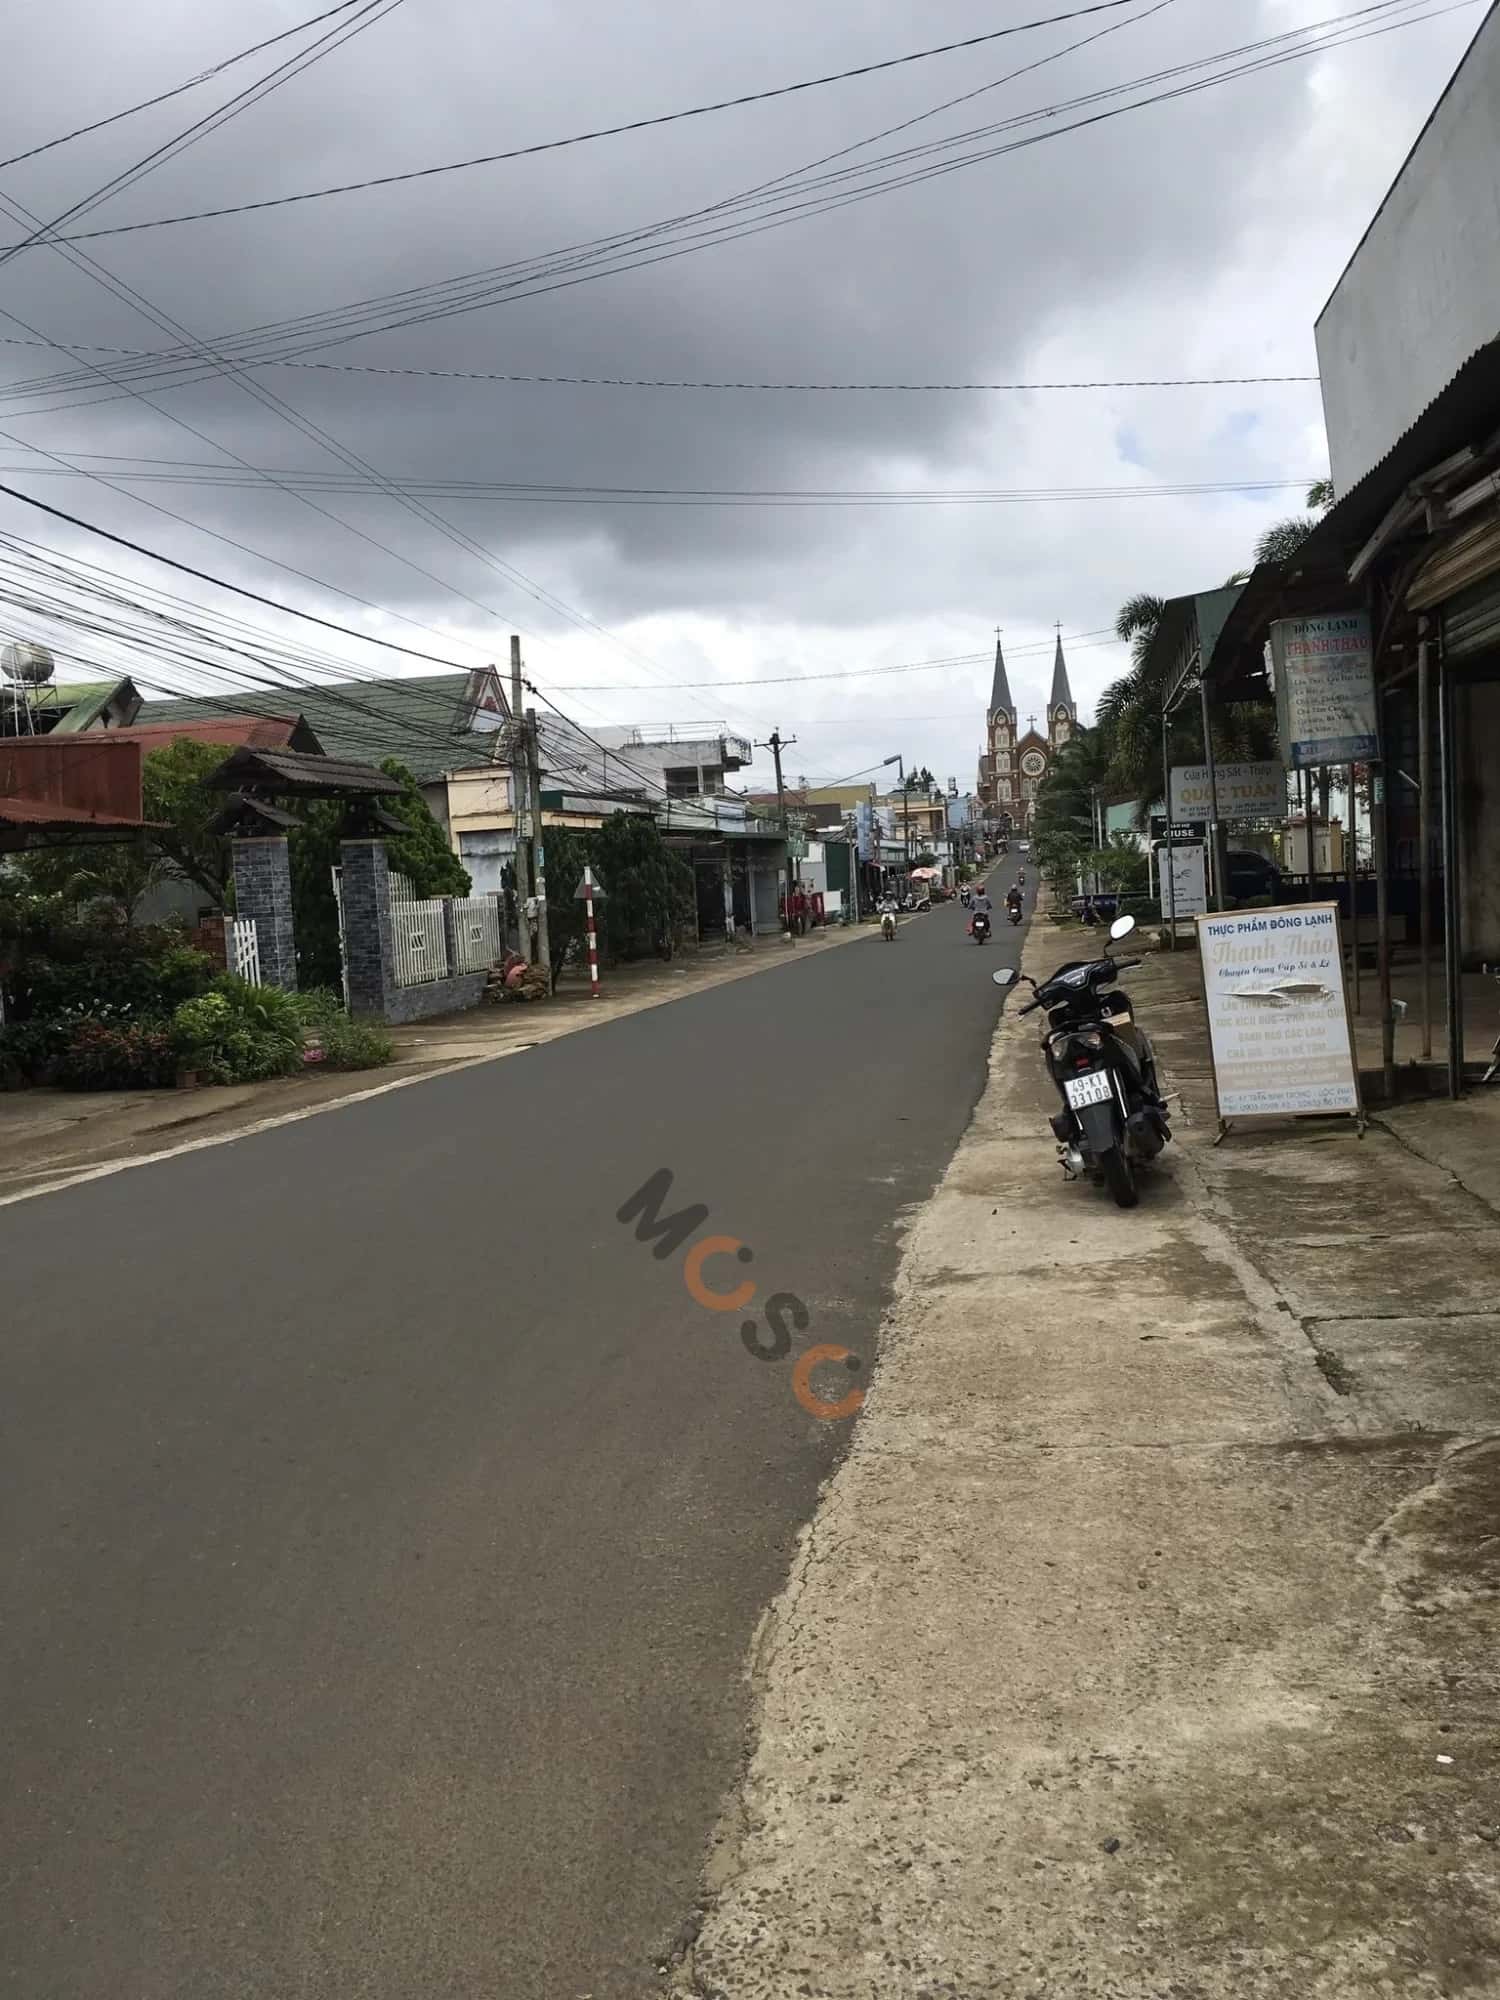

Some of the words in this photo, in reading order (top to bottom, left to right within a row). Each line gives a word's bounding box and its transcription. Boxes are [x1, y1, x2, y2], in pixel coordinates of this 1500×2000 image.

[1207, 923, 1235, 938] THỰC
[1237, 916, 1267, 934] PHẨM
[1270, 916, 1302, 931] ĐÔNG
[1305, 913, 1333, 928] LẠNH
[1213, 938, 1277, 963] Thanh
[1283, 930, 1334, 957] Thảo
